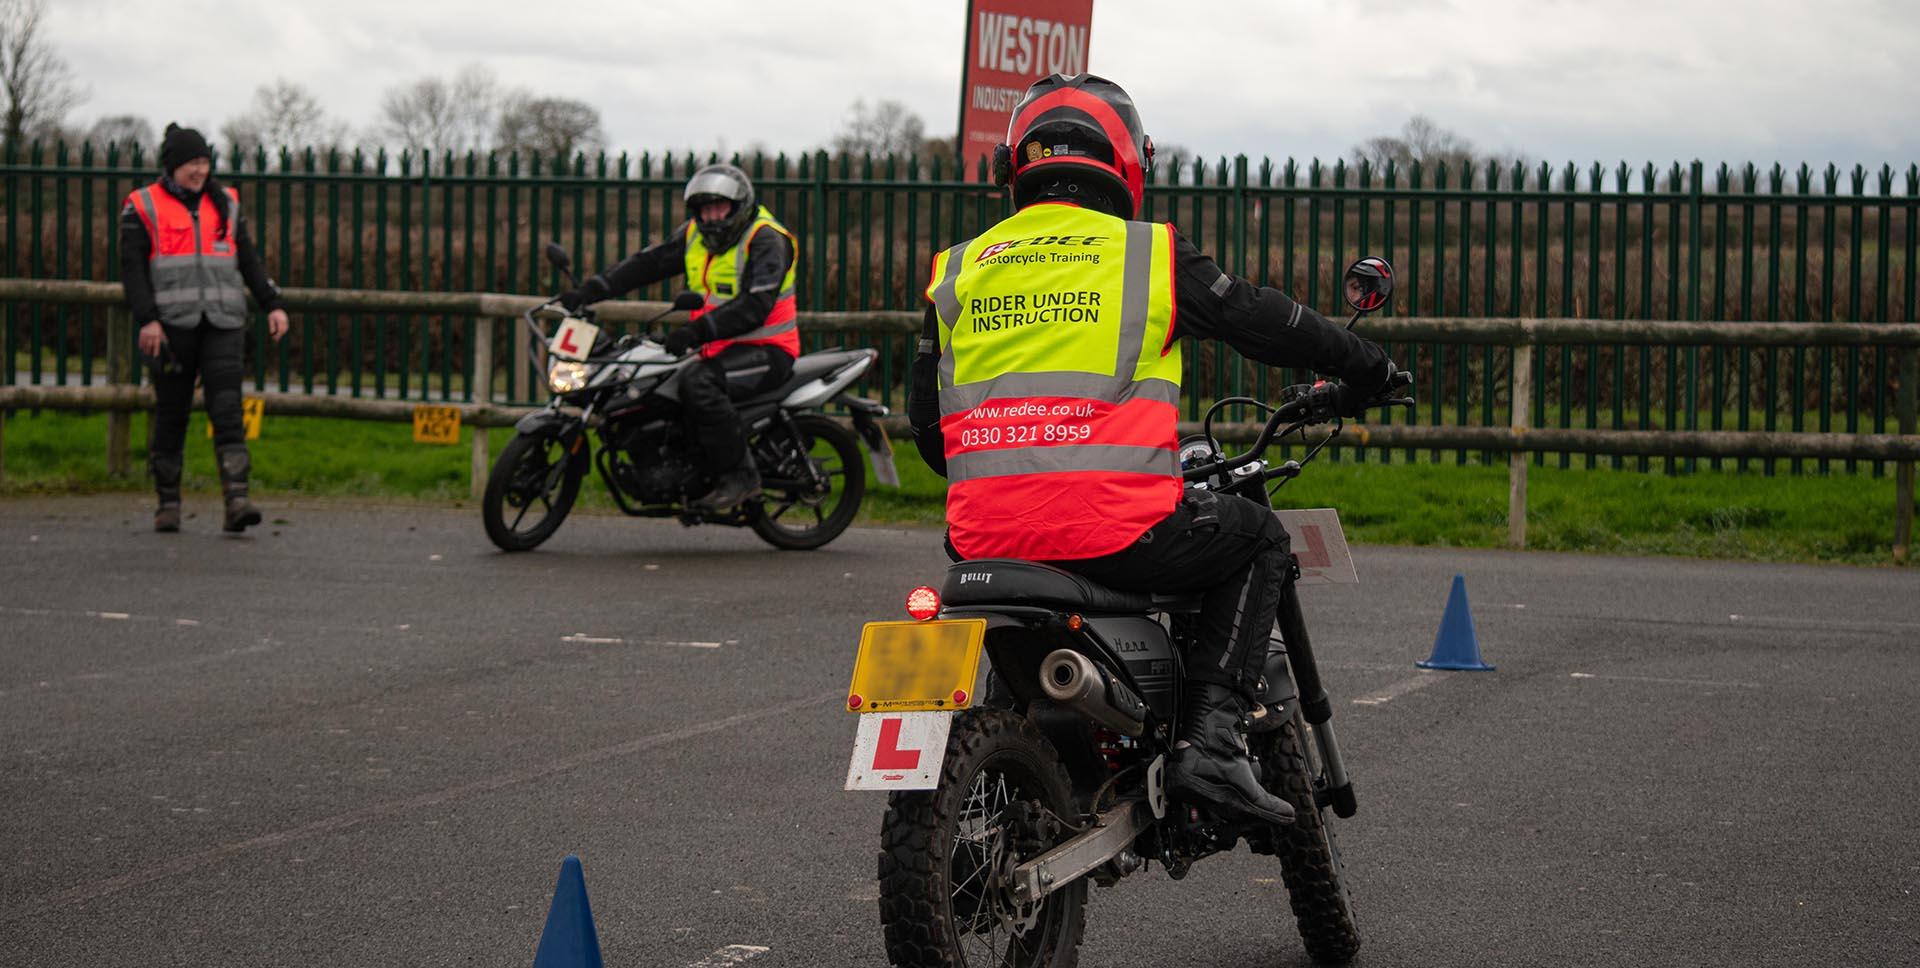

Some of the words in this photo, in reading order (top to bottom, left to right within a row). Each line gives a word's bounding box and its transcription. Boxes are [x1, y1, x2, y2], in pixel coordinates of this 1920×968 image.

[979, 11, 1086, 76] WESTON
[979, 251, 1046, 269] Motorcycle
[1050, 252, 1100, 264] Training
[971, 294, 1026, 315] RIDER
[1033, 291, 1101, 309] UNDER
[972, 307, 1099, 333] INSTRUCTION
[559, 328, 578, 353] L
[961, 427, 1001, 447] 0330
[1006, 425, 1037, 443] 321
[1043, 424, 1090, 441] 8959
[960, 572, 992, 584] BULLIT
[872, 718, 921, 770] L
